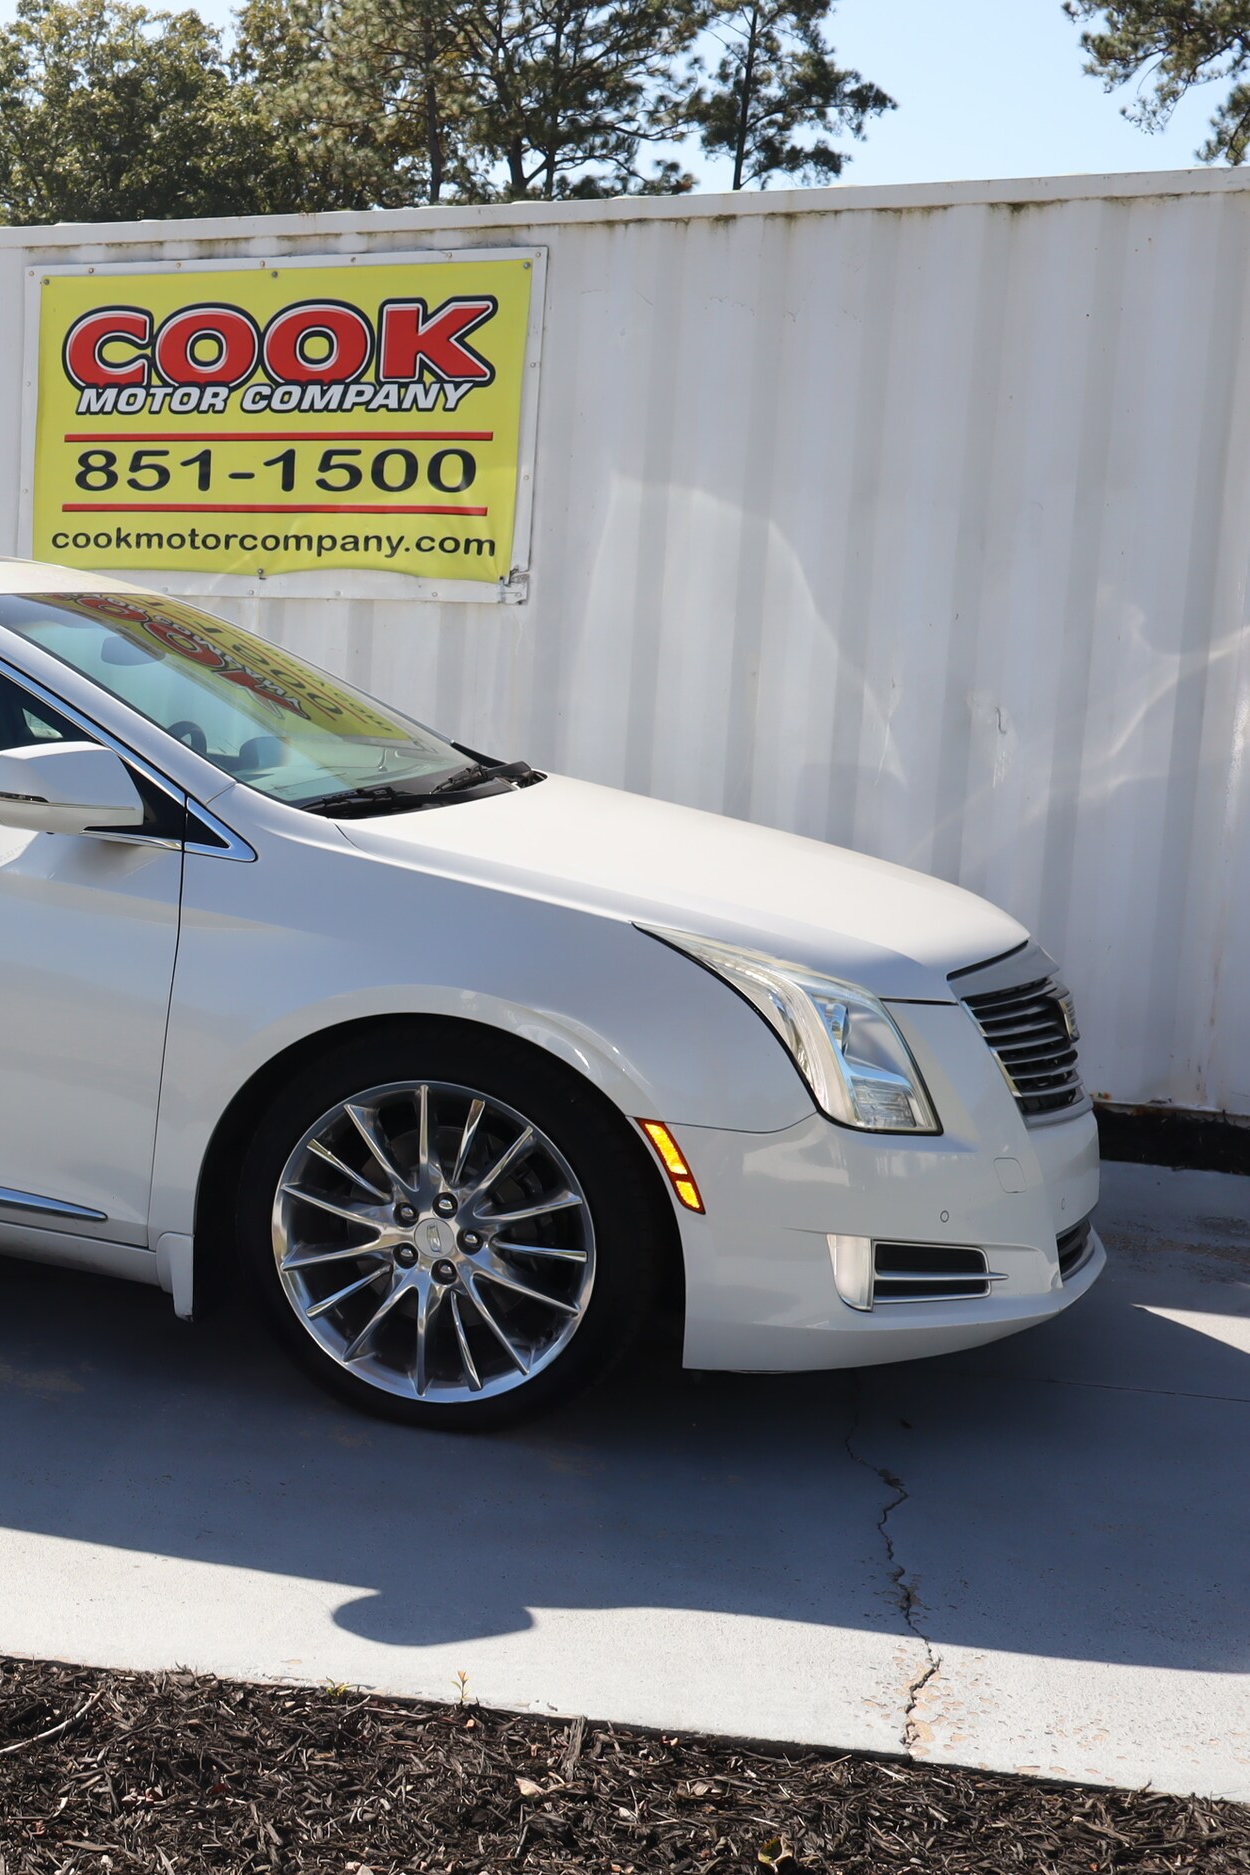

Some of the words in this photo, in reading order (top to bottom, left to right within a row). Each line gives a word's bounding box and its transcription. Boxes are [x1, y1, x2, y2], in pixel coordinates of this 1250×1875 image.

[63, 296, 498, 387] COOK
[75, 383, 229, 415] MOTOR
[240, 380, 473, 413] COMPANY
[74, 448, 477, 492] 851-1500
[51, 526, 496, 559] cookmotorcompany.com
